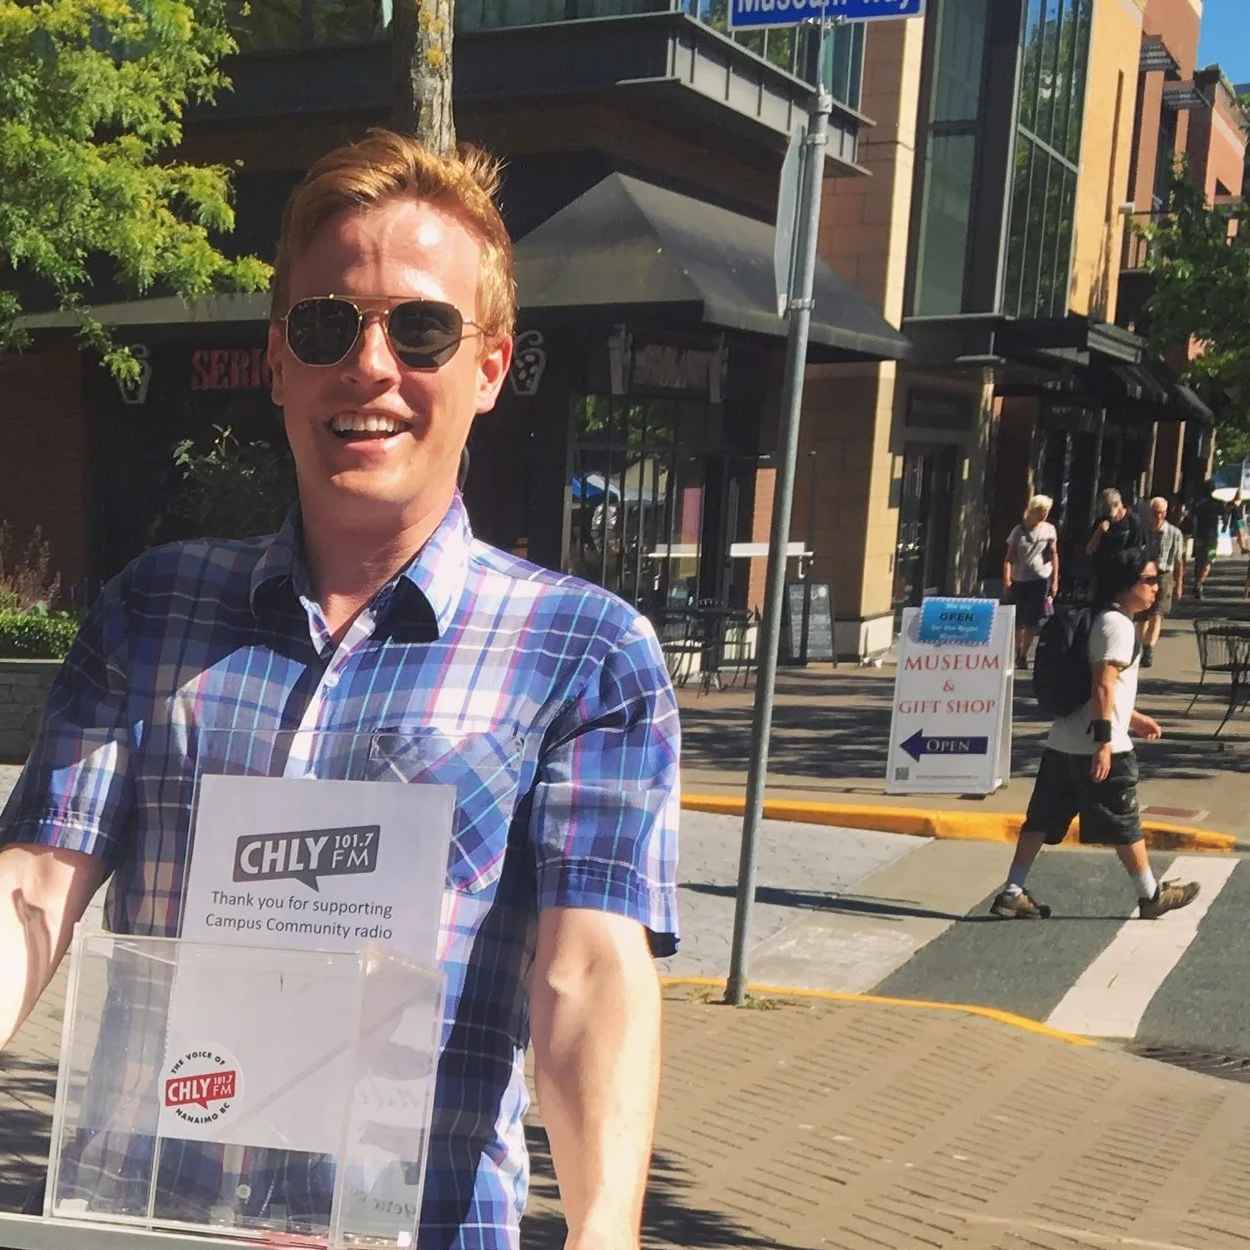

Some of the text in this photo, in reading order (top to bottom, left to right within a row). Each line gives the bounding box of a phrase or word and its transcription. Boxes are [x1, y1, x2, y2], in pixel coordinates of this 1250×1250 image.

[940, 612, 974, 622] OPEN
[904, 654, 1000, 670] MUSEUM
[942, 679, 955, 692] &
[899, 700, 995, 714] GIFT SHOP
[926, 739, 971, 752] OPEN
[240, 833, 375, 875] CHLY 101.7
[331, 849, 369, 869] FM
[211, 891, 393, 919] Thank you for supporting
[206, 914, 393, 939] Campus Community radio
[171, 1051, 226, 1074] THE VOICE OF
[168, 1078, 211, 1102] CHLY
[213, 1085, 232, 1096] FM
[175, 1102, 230, 1124] NANAIMO BC
